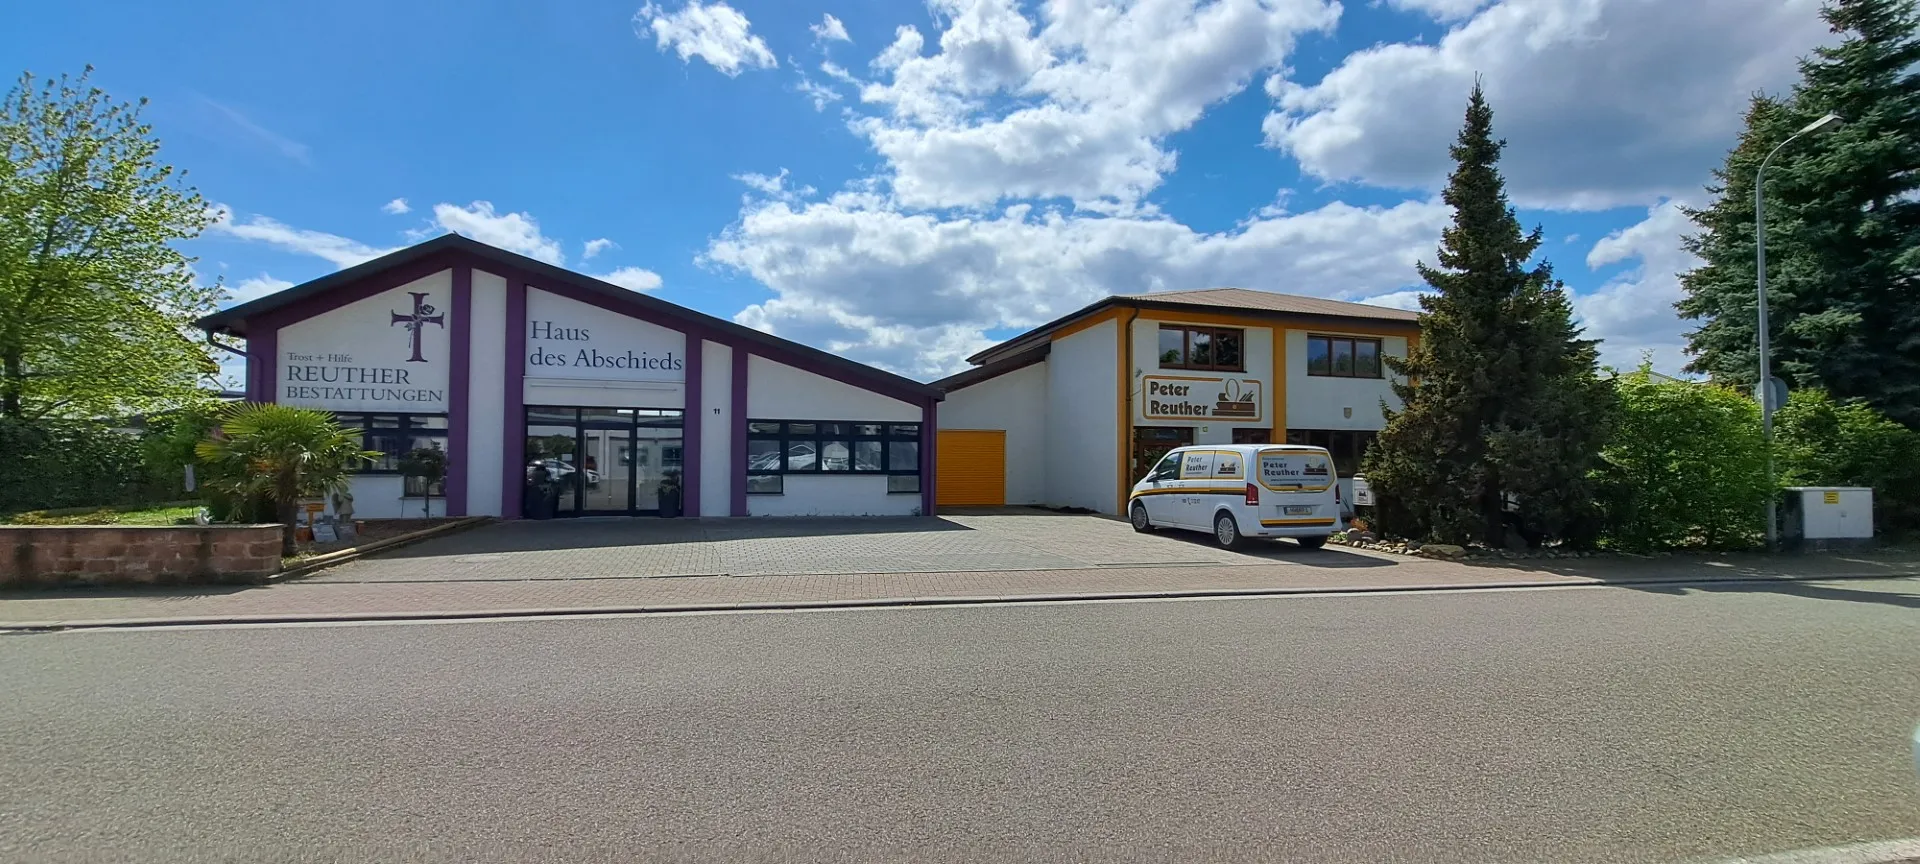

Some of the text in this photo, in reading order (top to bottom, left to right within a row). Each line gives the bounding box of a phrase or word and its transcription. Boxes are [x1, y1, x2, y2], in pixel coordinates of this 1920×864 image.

[530, 320, 589, 341] Haus
[287, 352, 313, 362] Trost
[328, 353, 353, 363] Hilfe
[529, 347, 682, 370] des Abschieds
[287, 365, 410, 384] REUTHER
[287, 386, 443, 401] BESTATTUNGEN
[1150, 381, 1189, 396] Peter
[1150, 400, 1208, 415] Reuther
[1185, 464, 1208, 472] Reuther
[1263, 461, 1288, 469] Peter
[1264, 469, 1300, 477] Reuther
